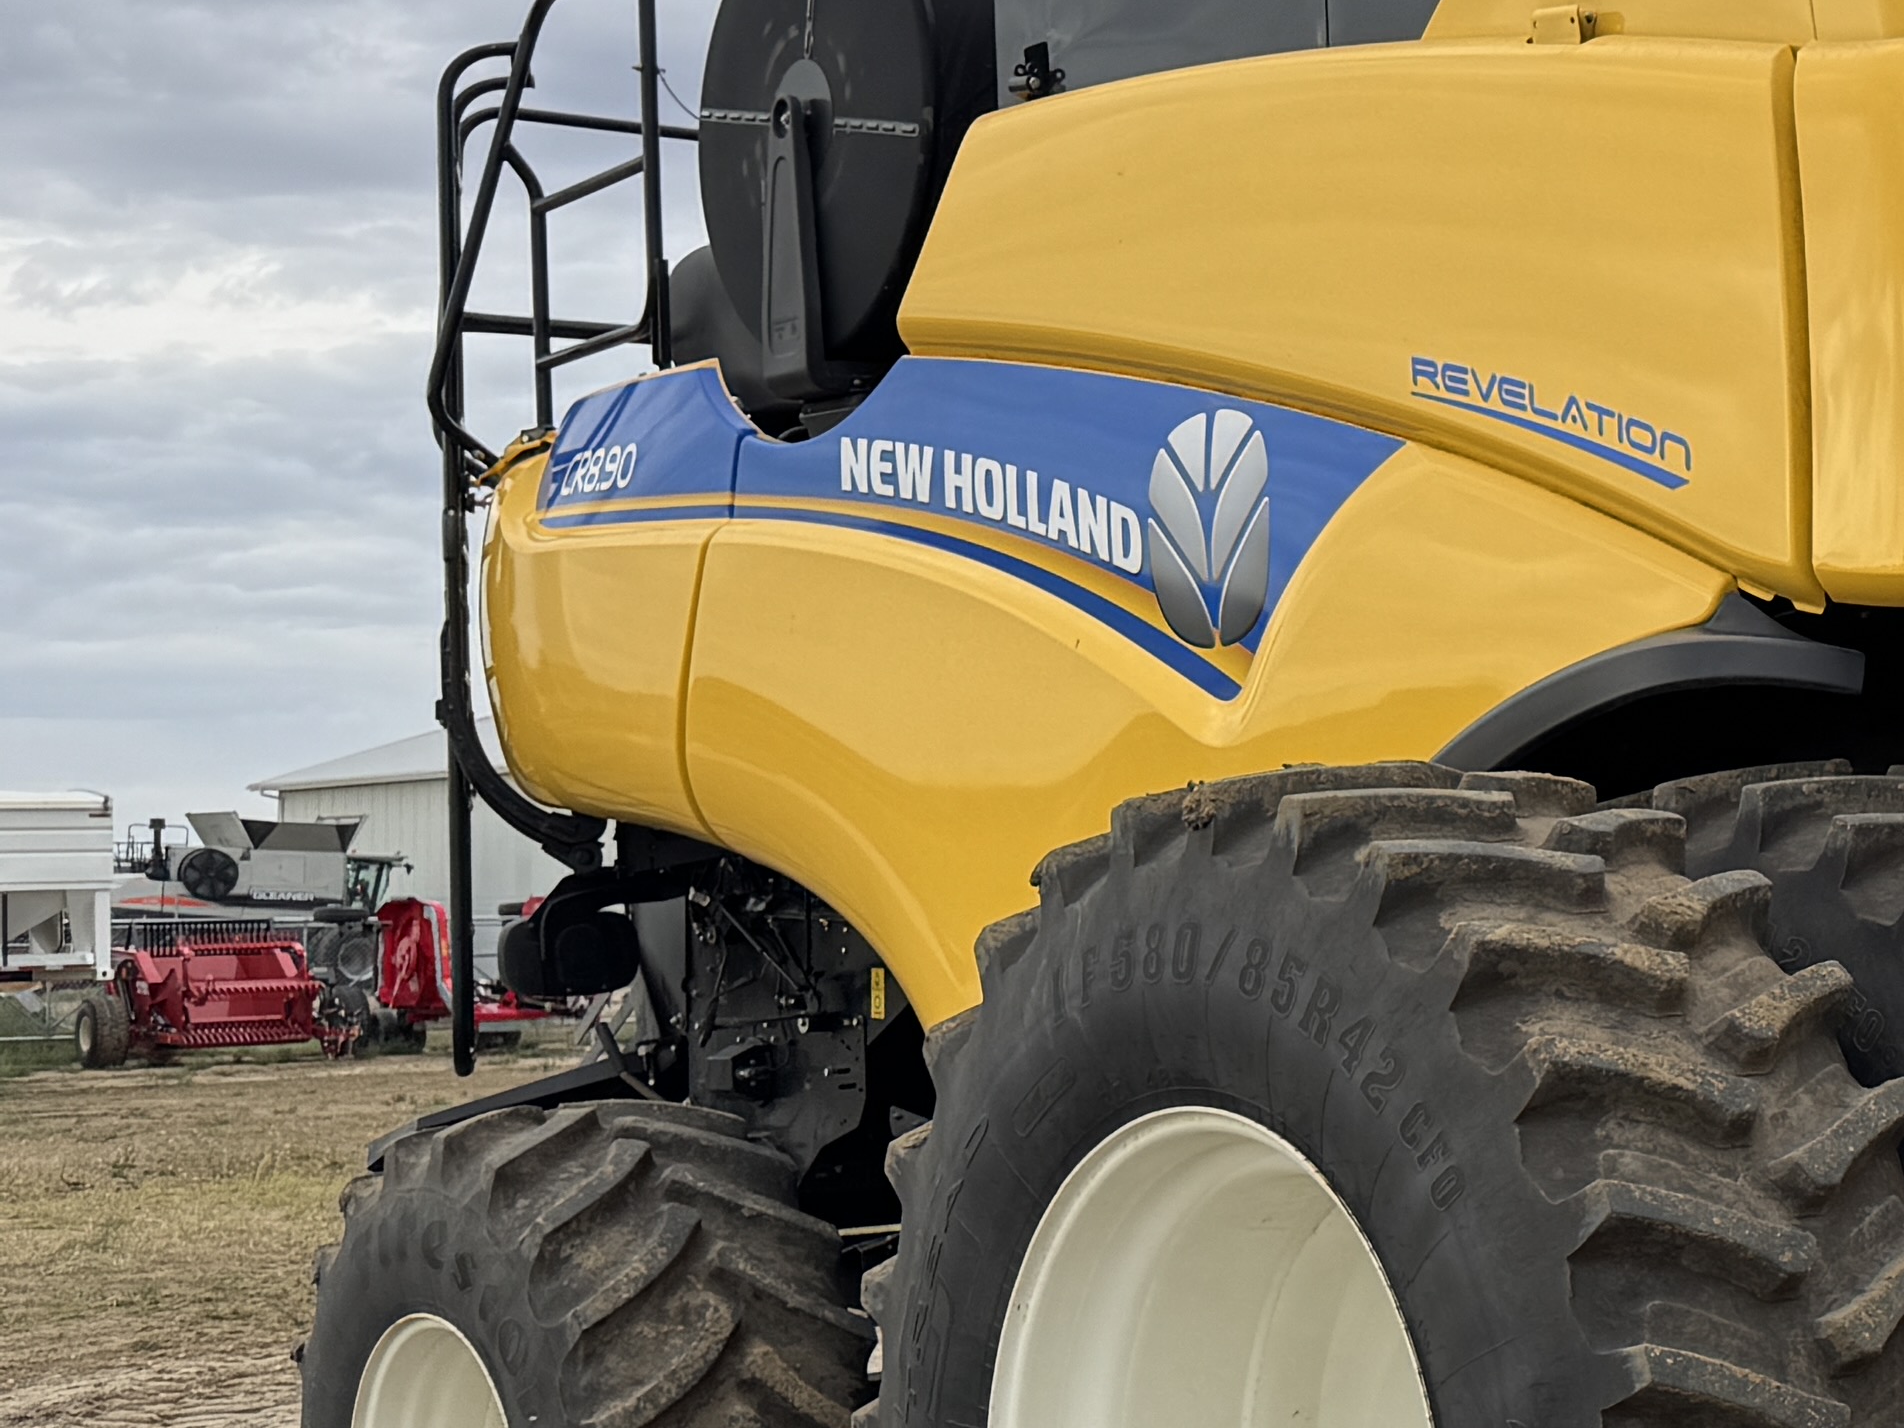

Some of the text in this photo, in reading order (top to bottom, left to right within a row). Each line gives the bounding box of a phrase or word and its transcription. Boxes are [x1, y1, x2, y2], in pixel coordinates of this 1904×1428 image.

[560, 442, 638, 497] CR8.90
[1410, 355, 1692, 472] REVELATION
[839, 435, 1144, 575] NEW HOLLAND
